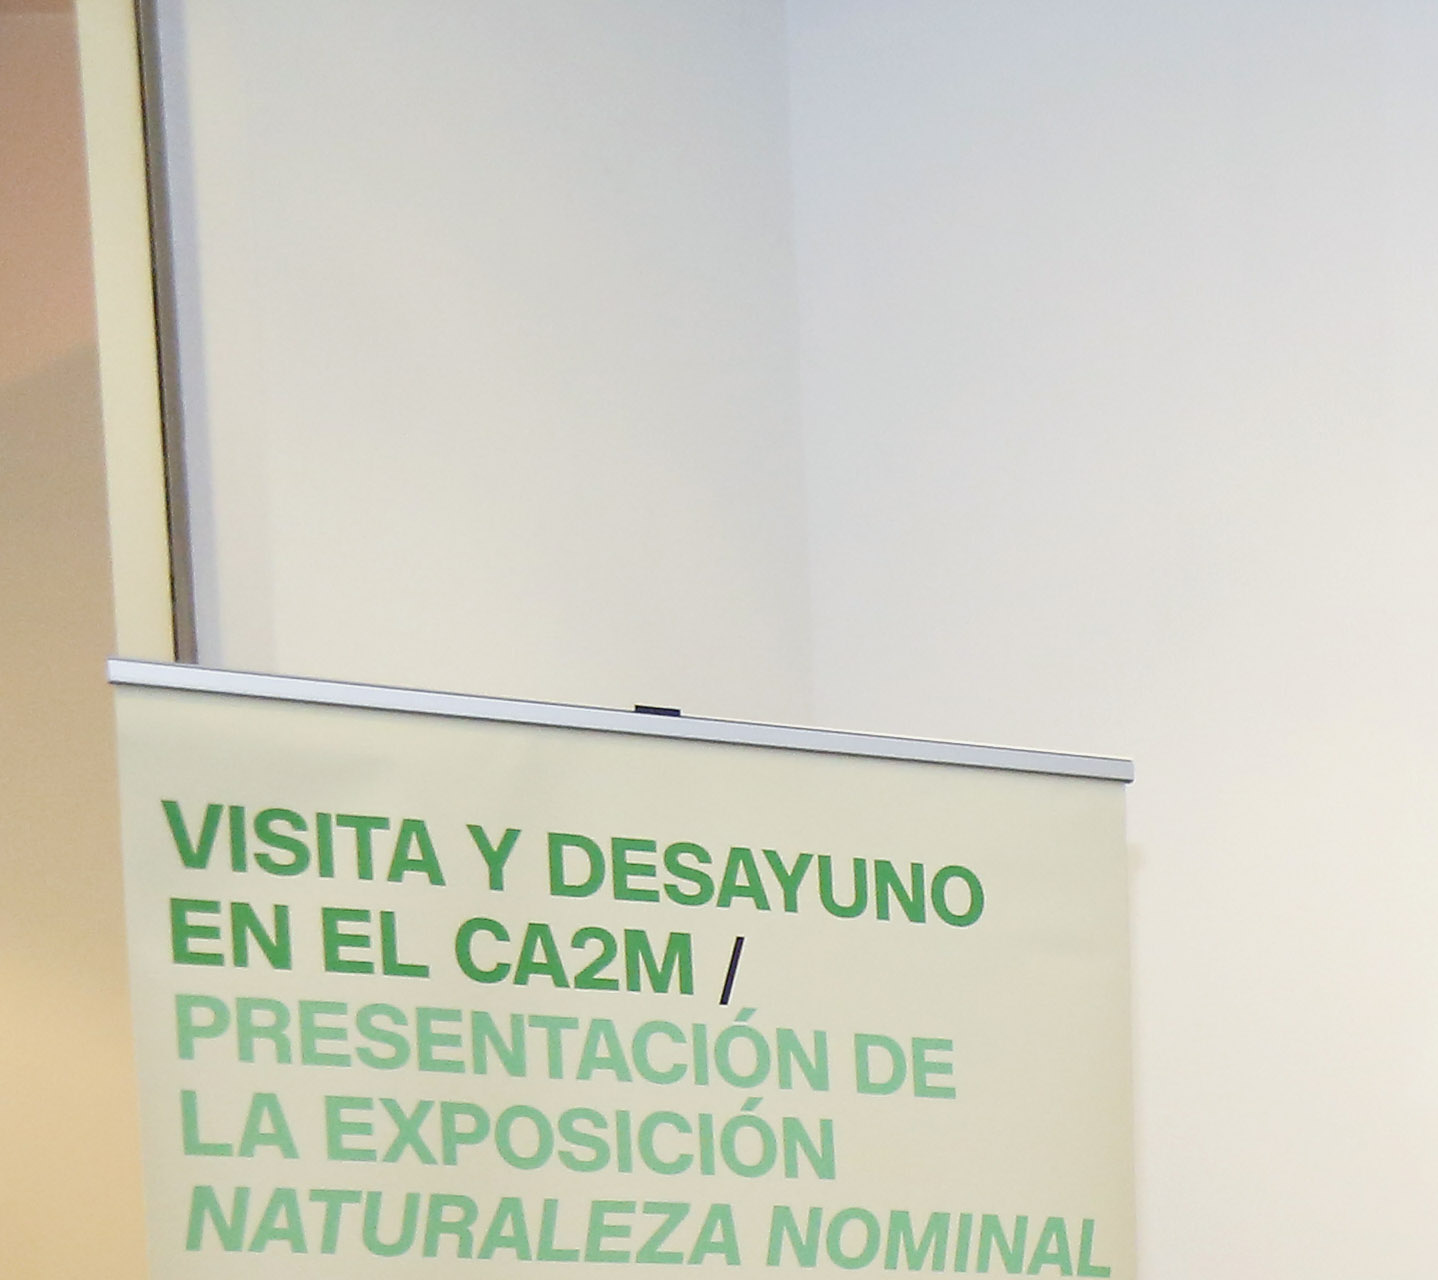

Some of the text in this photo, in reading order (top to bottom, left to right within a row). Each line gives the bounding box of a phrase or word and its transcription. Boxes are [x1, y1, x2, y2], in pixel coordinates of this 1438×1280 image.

[161, 800, 985, 928] VISITA Y DESAYUNO
[170, 898, 744, 1006] EN EL CA2M /
[176, 994, 957, 1100] PRESENTACIÓN DE
[179, 1091, 836, 1180] LA EXPOSICIÓN
[184, 1185, 1112, 1279] NATURALEZA NOMINAL
